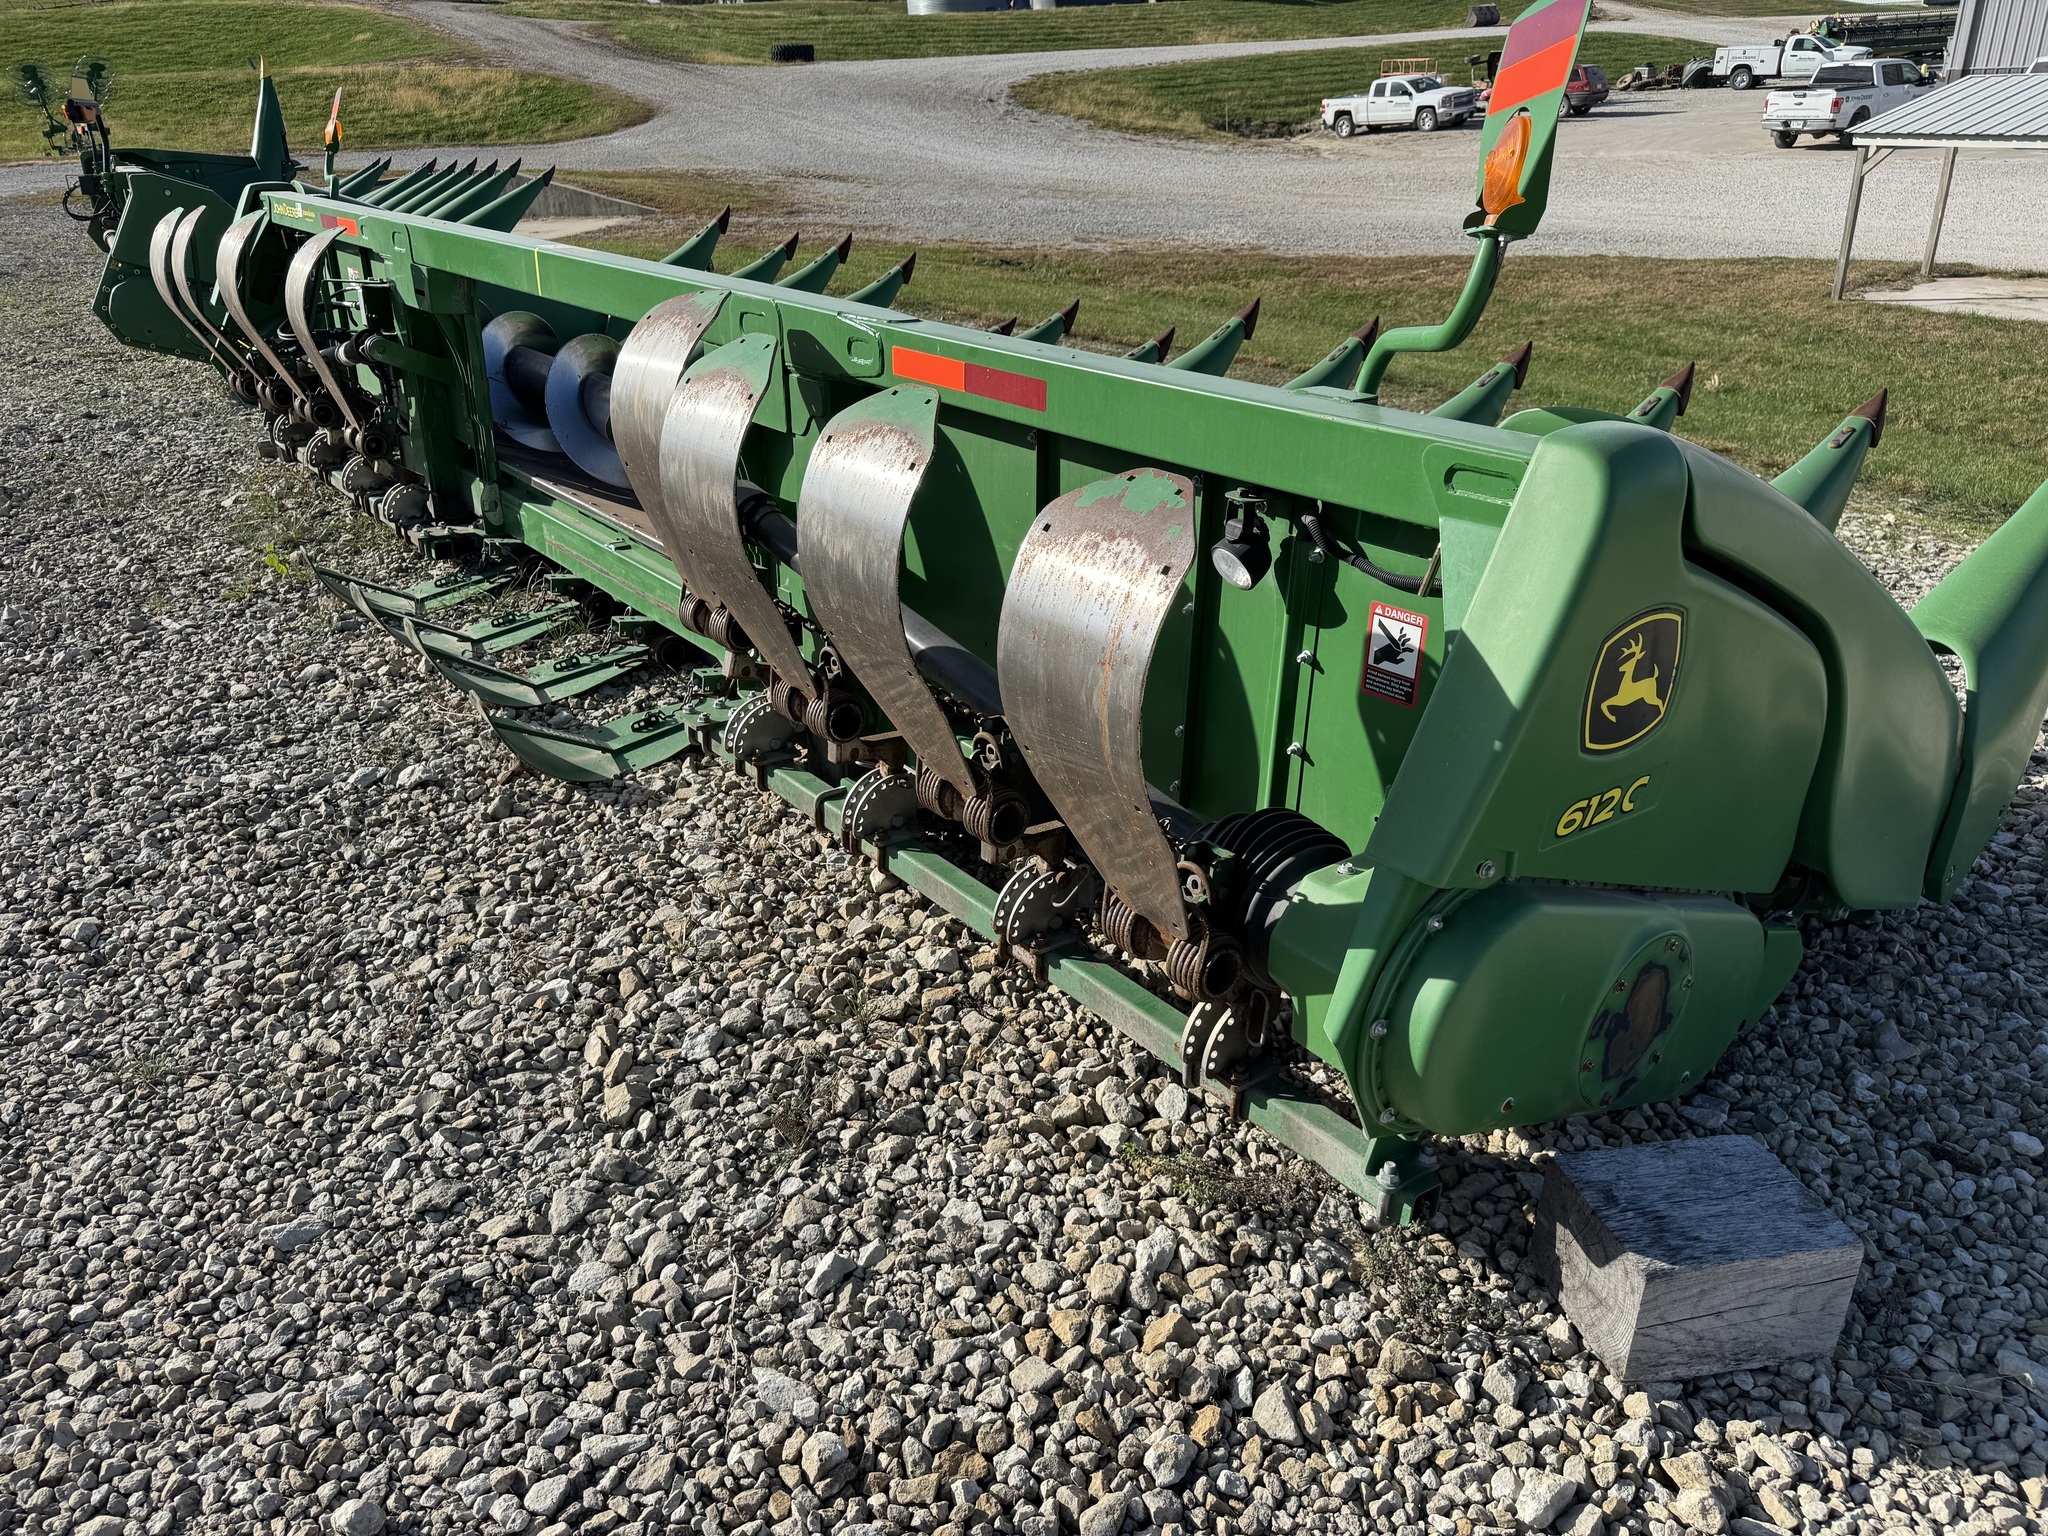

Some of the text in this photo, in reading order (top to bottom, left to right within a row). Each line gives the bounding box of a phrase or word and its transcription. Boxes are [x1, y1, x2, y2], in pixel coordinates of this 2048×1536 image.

[1384, 607, 1423, 626] DANGER
[1366, 684, 1379, 692] opening
[1555, 774, 1651, 838] 612C
